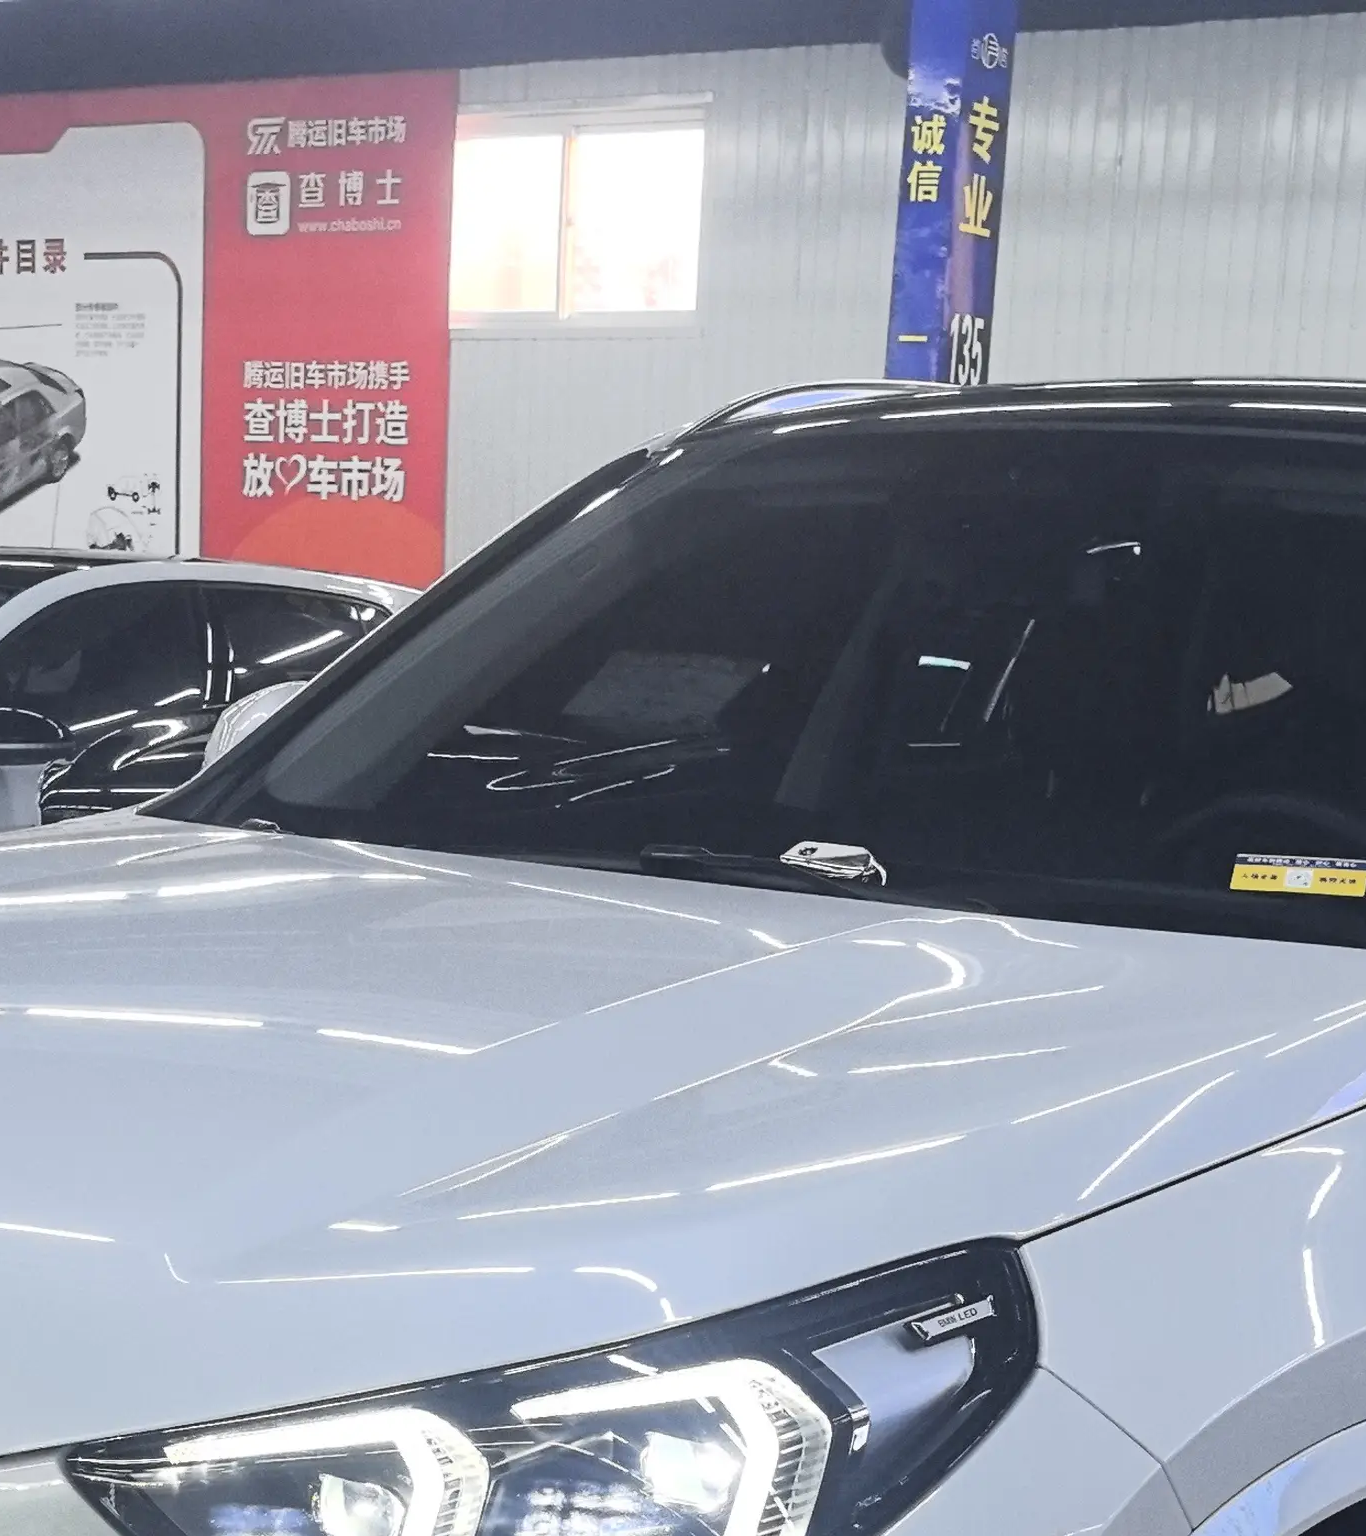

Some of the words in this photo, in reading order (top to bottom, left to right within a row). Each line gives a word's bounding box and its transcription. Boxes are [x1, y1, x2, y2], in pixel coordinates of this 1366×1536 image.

[287, 115, 407, 148] 腾运旧车市场
[907, 114, 947, 203] 诚信
[959, 96, 1000, 238] 专业
[298, 169, 402, 208] 查博士
[297, 217, 402, 233] www.chaboshi.cn
[242, 360, 410, 390] 腾运旧车市场携手
[243, 398, 410, 445] 查博士打造
[957, 1306, 979, 1321] LED
